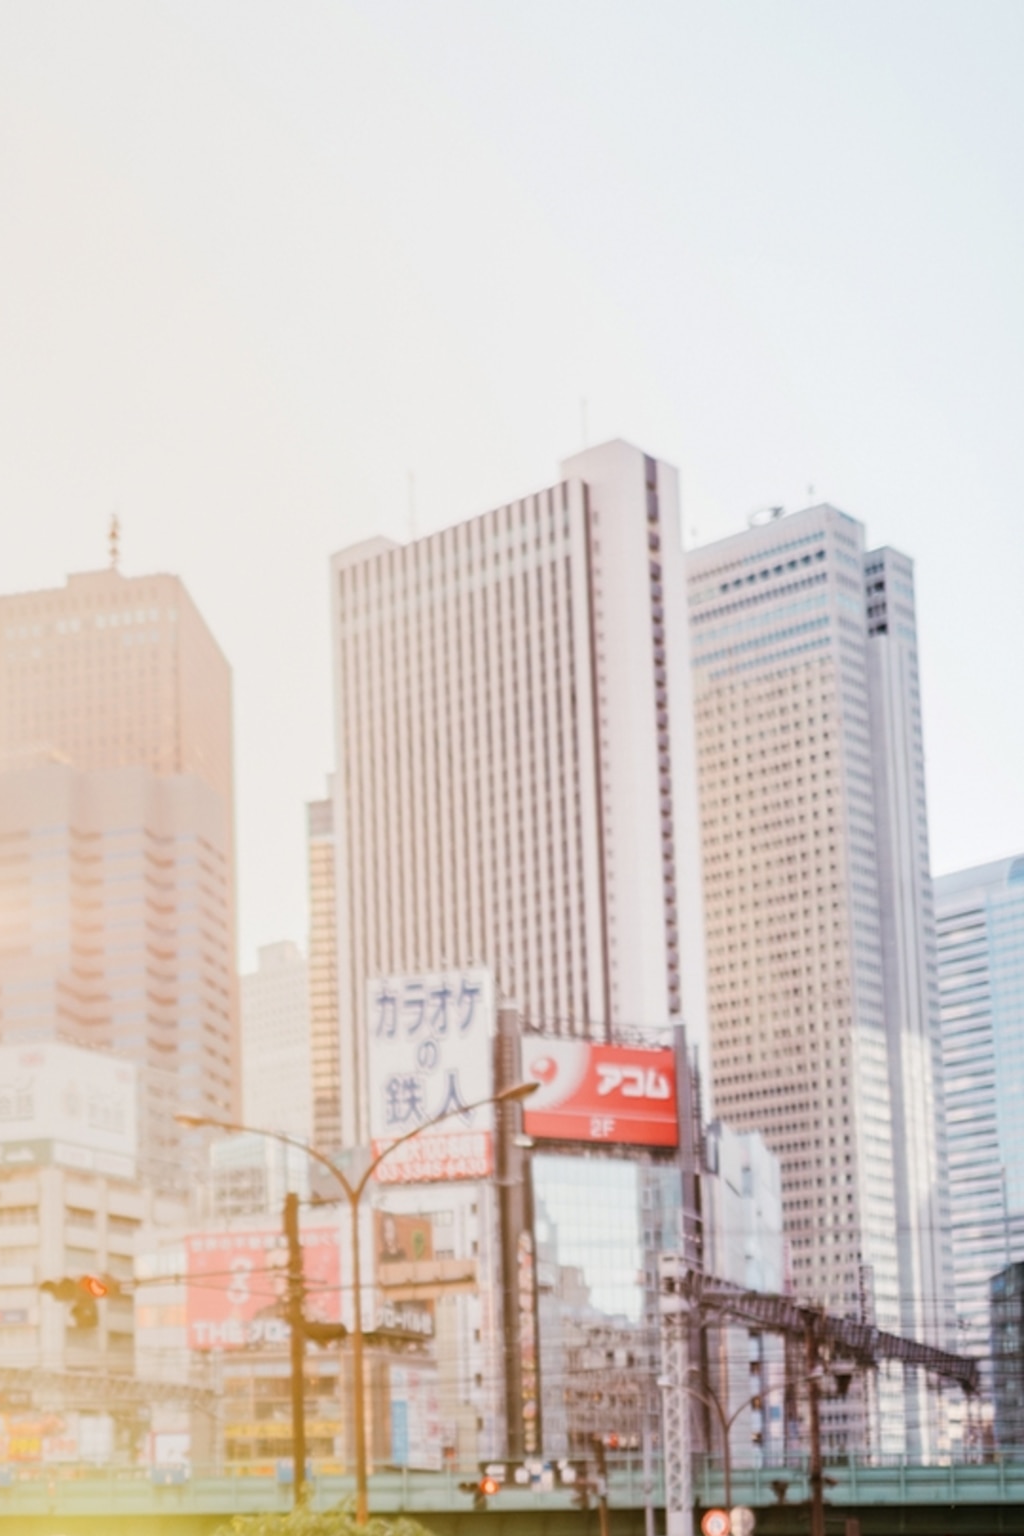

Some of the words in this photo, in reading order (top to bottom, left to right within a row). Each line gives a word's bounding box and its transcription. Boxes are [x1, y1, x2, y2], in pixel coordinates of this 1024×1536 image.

[376, 979, 481, 1038] カラオケ
[417, 1040, 437, 1068] の
[596, 1062, 671, 1099] アコム
[386, 1074, 472, 1127] 鉄人
[589, 1118, 615, 1138] 2F
